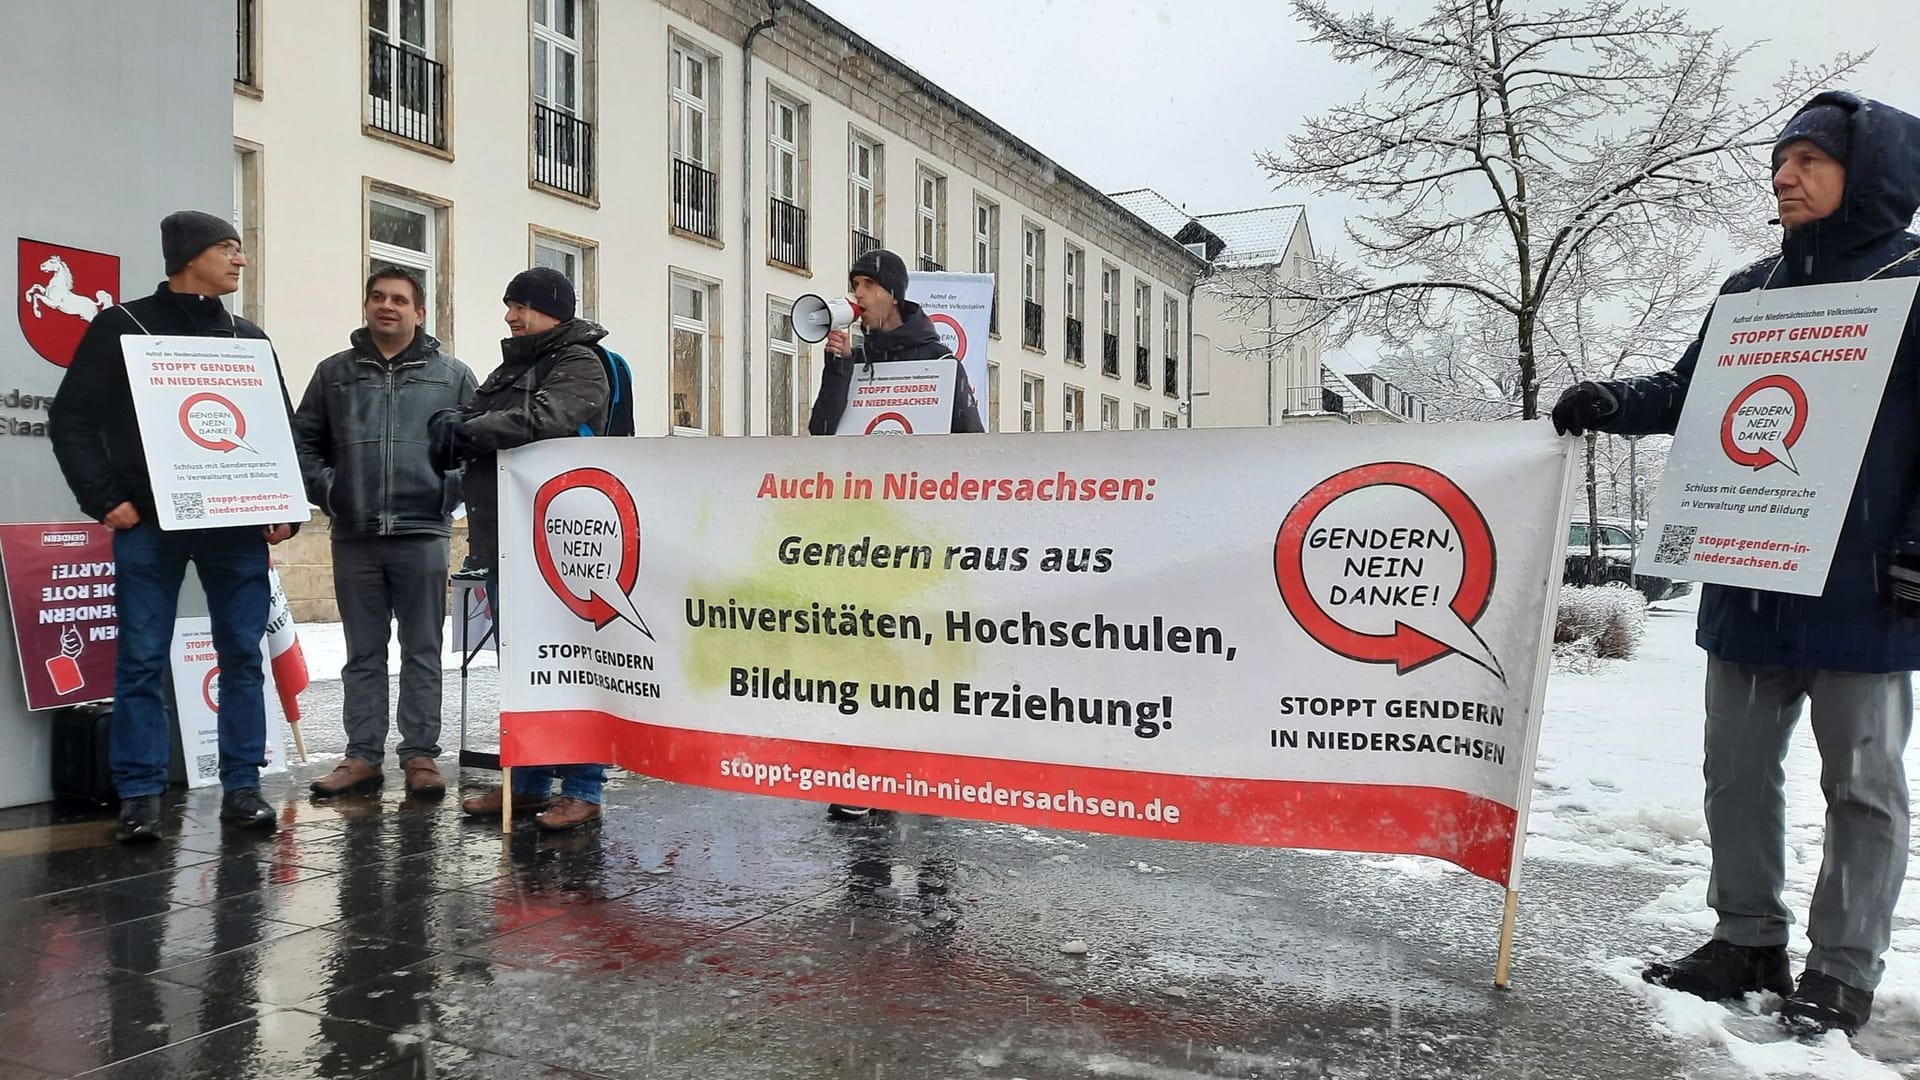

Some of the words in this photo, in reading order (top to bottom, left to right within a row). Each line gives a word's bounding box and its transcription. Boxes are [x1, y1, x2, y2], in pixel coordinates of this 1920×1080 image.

[1732, 315, 1753, 324] Aufruf
[1753, 314, 1765, 322] der
[1826, 305, 1879, 317] Volksinitiative
[1729, 329, 1786, 345] STOPPT
[1788, 324, 1869, 341] GENDERN
[1717, 354, 1735, 367] IN
[1737, 347, 1869, 366] NIEDERSACHSEN
[152, 362, 197, 371] STOPPT
[200, 363, 256, 373] GENDERN
[150, 377, 163, 385] IN
[168, 377, 263, 386] NIEDERSACHSEN
[857, 386, 892, 395] STOPPT
[893, 384, 937, 394] GENDERN
[852, 400, 863, 408] IN
[865, 397, 939, 407] NIEDERSACHSEN
[1738, 405, 1793, 417] GENDERN,
[1747, 418, 1779, 428] NEIN
[1738, 431, 1782, 441] DANKE!
[220, 461, 277, 469] Gendersprache
[186, 473, 232, 481] Verwaltung
[250, 471, 278, 479] Bildung
[756, 471, 834, 499] Auch
[843, 471, 873, 500] in
[882, 471, 1157, 501] Niedersachsen:
[1684, 483, 1718, 493] Schluss
[1720, 485, 1737, 495] mit
[1739, 485, 1817, 499] Gendersprache
[207, 492, 292, 504] stoppt-gendern-in-
[209, 504, 289, 515] niedersachsen.de
[1681, 499, 1690, 508] in
[1692, 499, 1746, 514] Verwaltung
[1748, 503, 1768, 513] und
[1769, 504, 1810, 518] Bildung
[546, 519, 619, 539] GENDERN,
[563, 540, 602, 557] NEIN
[1309, 527, 1455, 552] GENDERN,
[1698, 534, 1811, 554] stoppt-gendern-in-
[778, 536, 932, 569] Gendern
[944, 545, 1030, 571] raus
[1039, 546, 1114, 573] aus
[1693, 552, 1799, 572] niedersachsen.de
[52, 561, 116, 580] KARTE!
[561, 561, 611, 580] DANKE!
[1344, 556, 1424, 578] NEIN
[42, 584, 90, 602] ROTE
[1329, 585, 1440, 607] DANKE!
[89, 625, 119, 641] EM
[685, 598, 933, 646] Universitäten,
[945, 610, 1237, 661] Hochschulen,
[184, 654, 194, 662] IN
[538, 644, 593, 662] STOPPT
[594, 648, 654, 672] GENDERN
[530, 671, 551, 686] IN
[558, 670, 661, 699] NIEDERSACHSEN
[730, 666, 859, 715] Bildung
[870, 679, 939, 712] und
[953, 683, 1173, 738] Erziehung!
[1280, 696, 1378, 718] STOPPT
[1384, 699, 1505, 727] GENDERN
[1270, 729, 1299, 748] IN
[1307, 730, 1505, 765] NIEDERSACHSEN
[719, 756, 1181, 824] stoppt-gendern-in-niedersachsen.de
